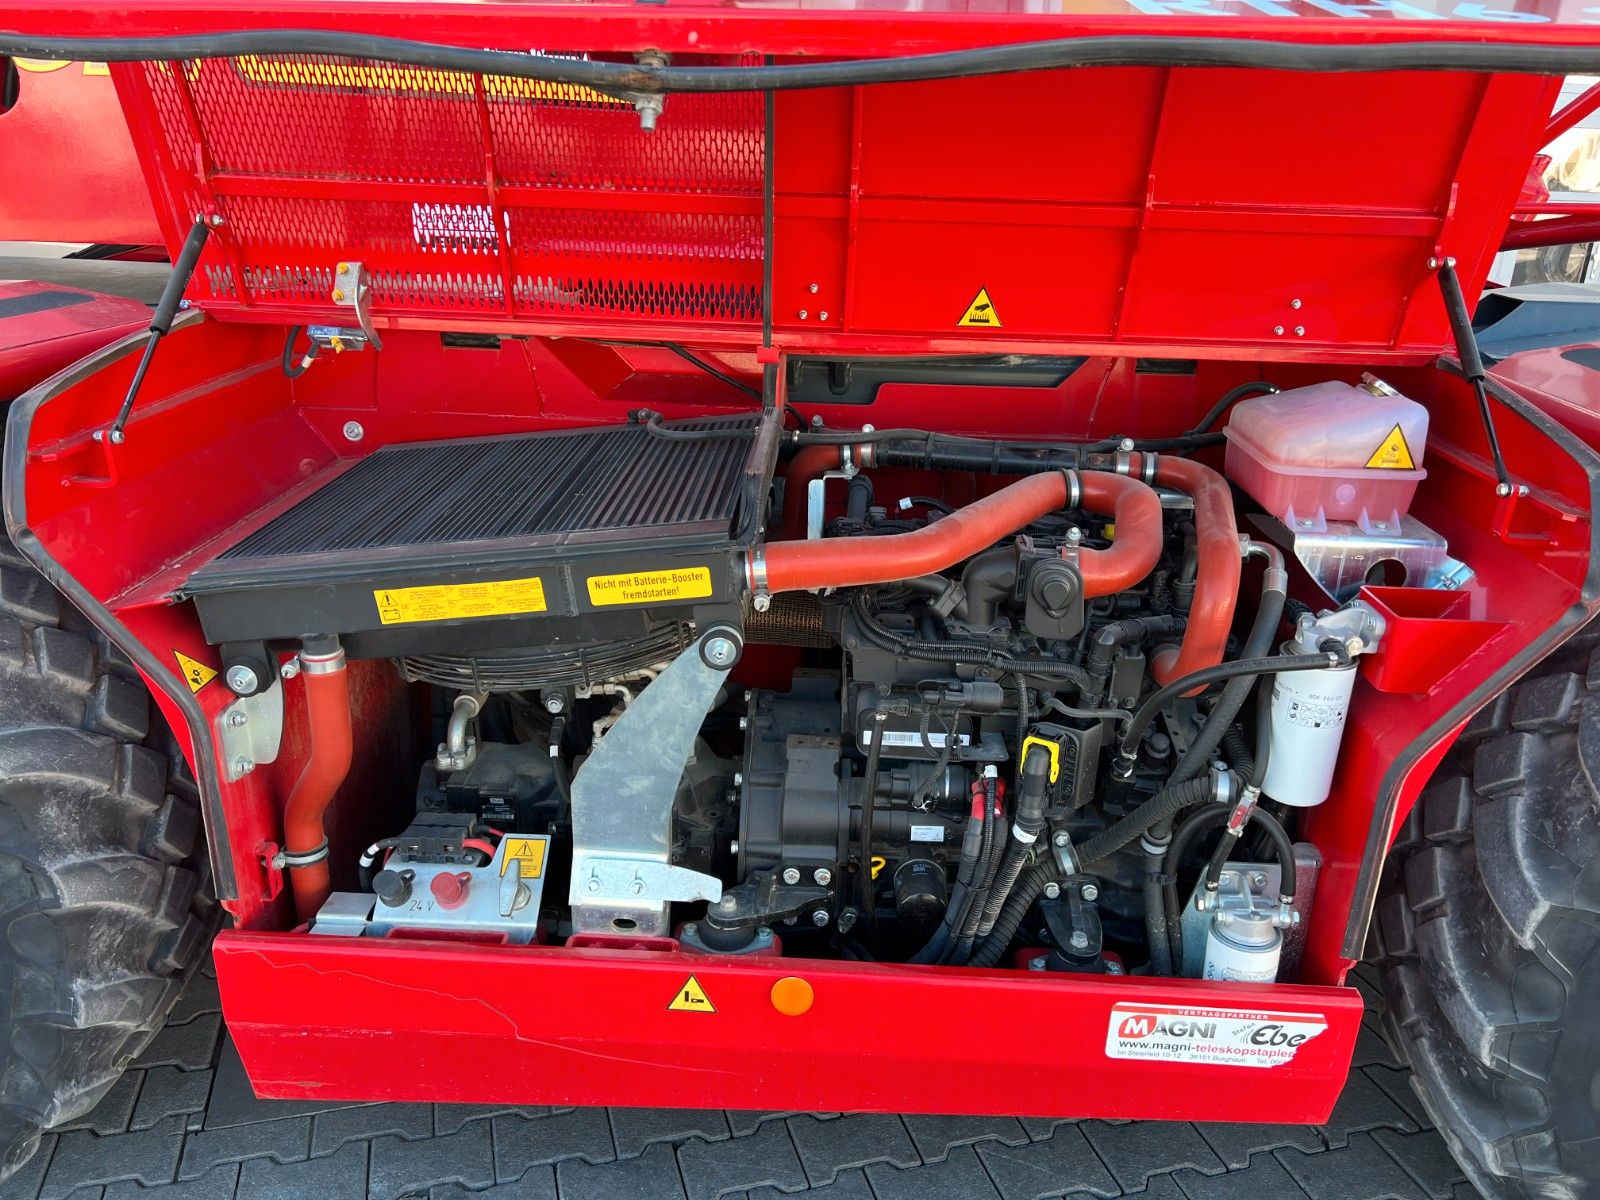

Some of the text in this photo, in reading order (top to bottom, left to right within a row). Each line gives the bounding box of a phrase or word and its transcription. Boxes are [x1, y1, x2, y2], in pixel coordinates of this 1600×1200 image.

[594, 572, 703, 589] Nicht mit Batterie-Booster
[623, 586, 679, 600] fremdstarten!
[410, 899, 435, 911] 24 V
[1178, 1009, 1268, 1020] VERTRAGSPARTNER
[1123, 1018, 1217, 1039] MAGNI
[1232, 1022, 1256, 1037] Stefan
[1250, 1024, 1317, 1048] Ebe
